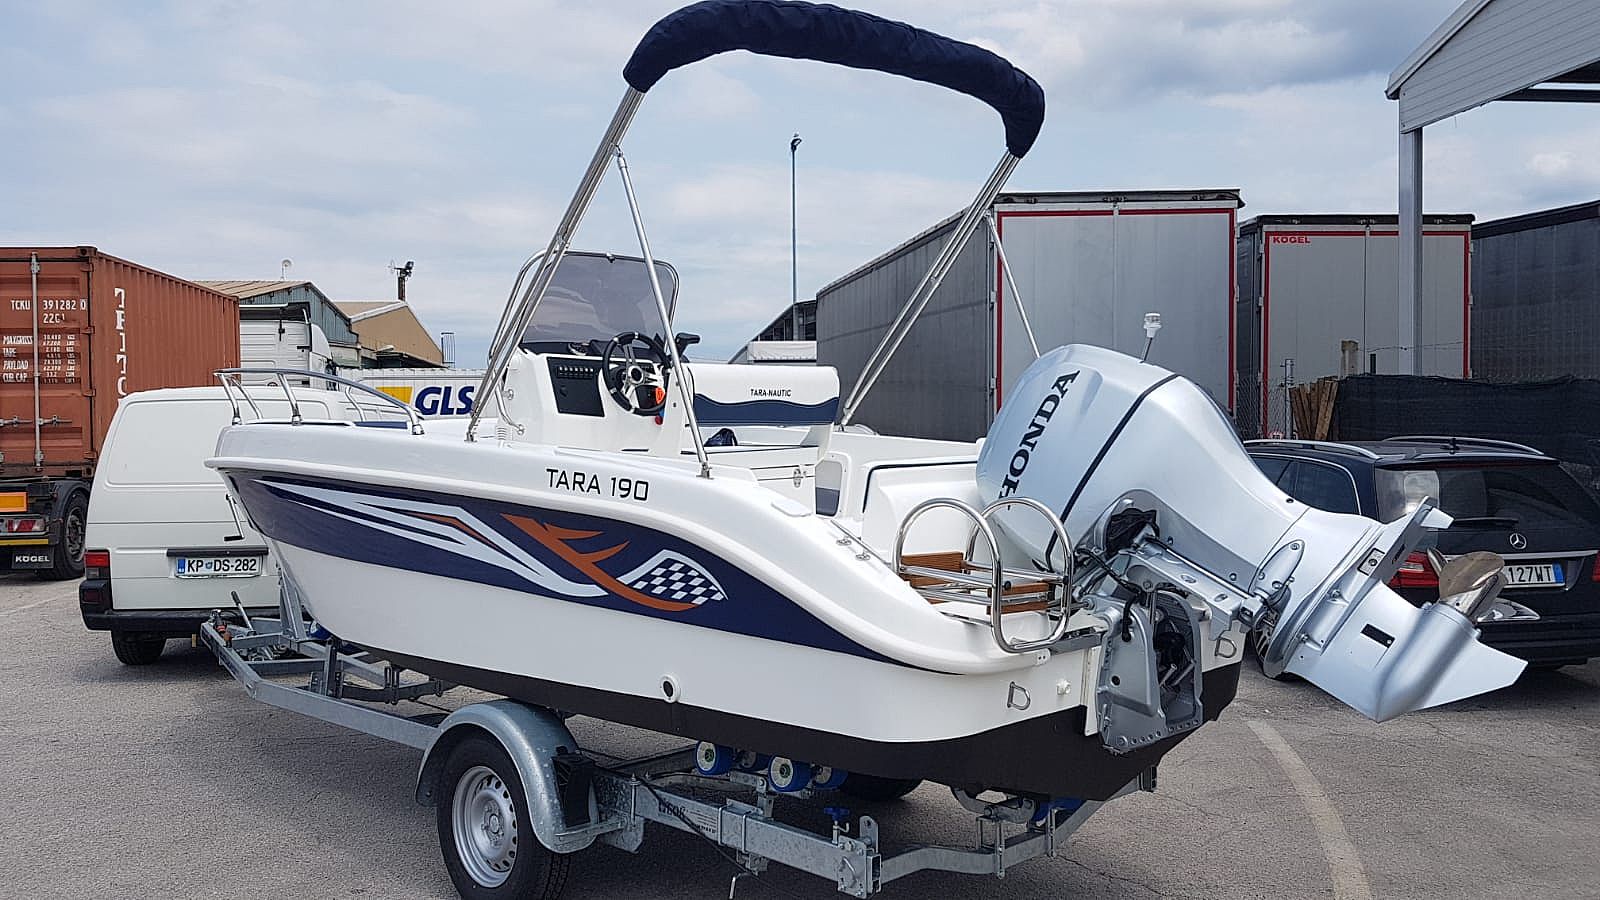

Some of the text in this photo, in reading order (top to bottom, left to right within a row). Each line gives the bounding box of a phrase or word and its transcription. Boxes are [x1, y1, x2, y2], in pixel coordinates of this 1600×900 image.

[11, 299, 87, 310] TCKU 391282 0
[3, 360, 29, 370] PAYLOAD
[415, 386, 475, 415] GLS
[999, 370, 1080, 509] HONDA
[546, 468, 649, 501] TARA 190
[187, 559, 257, 572] KP DS-282
[1508, 566, 1552, 583] 127WT
